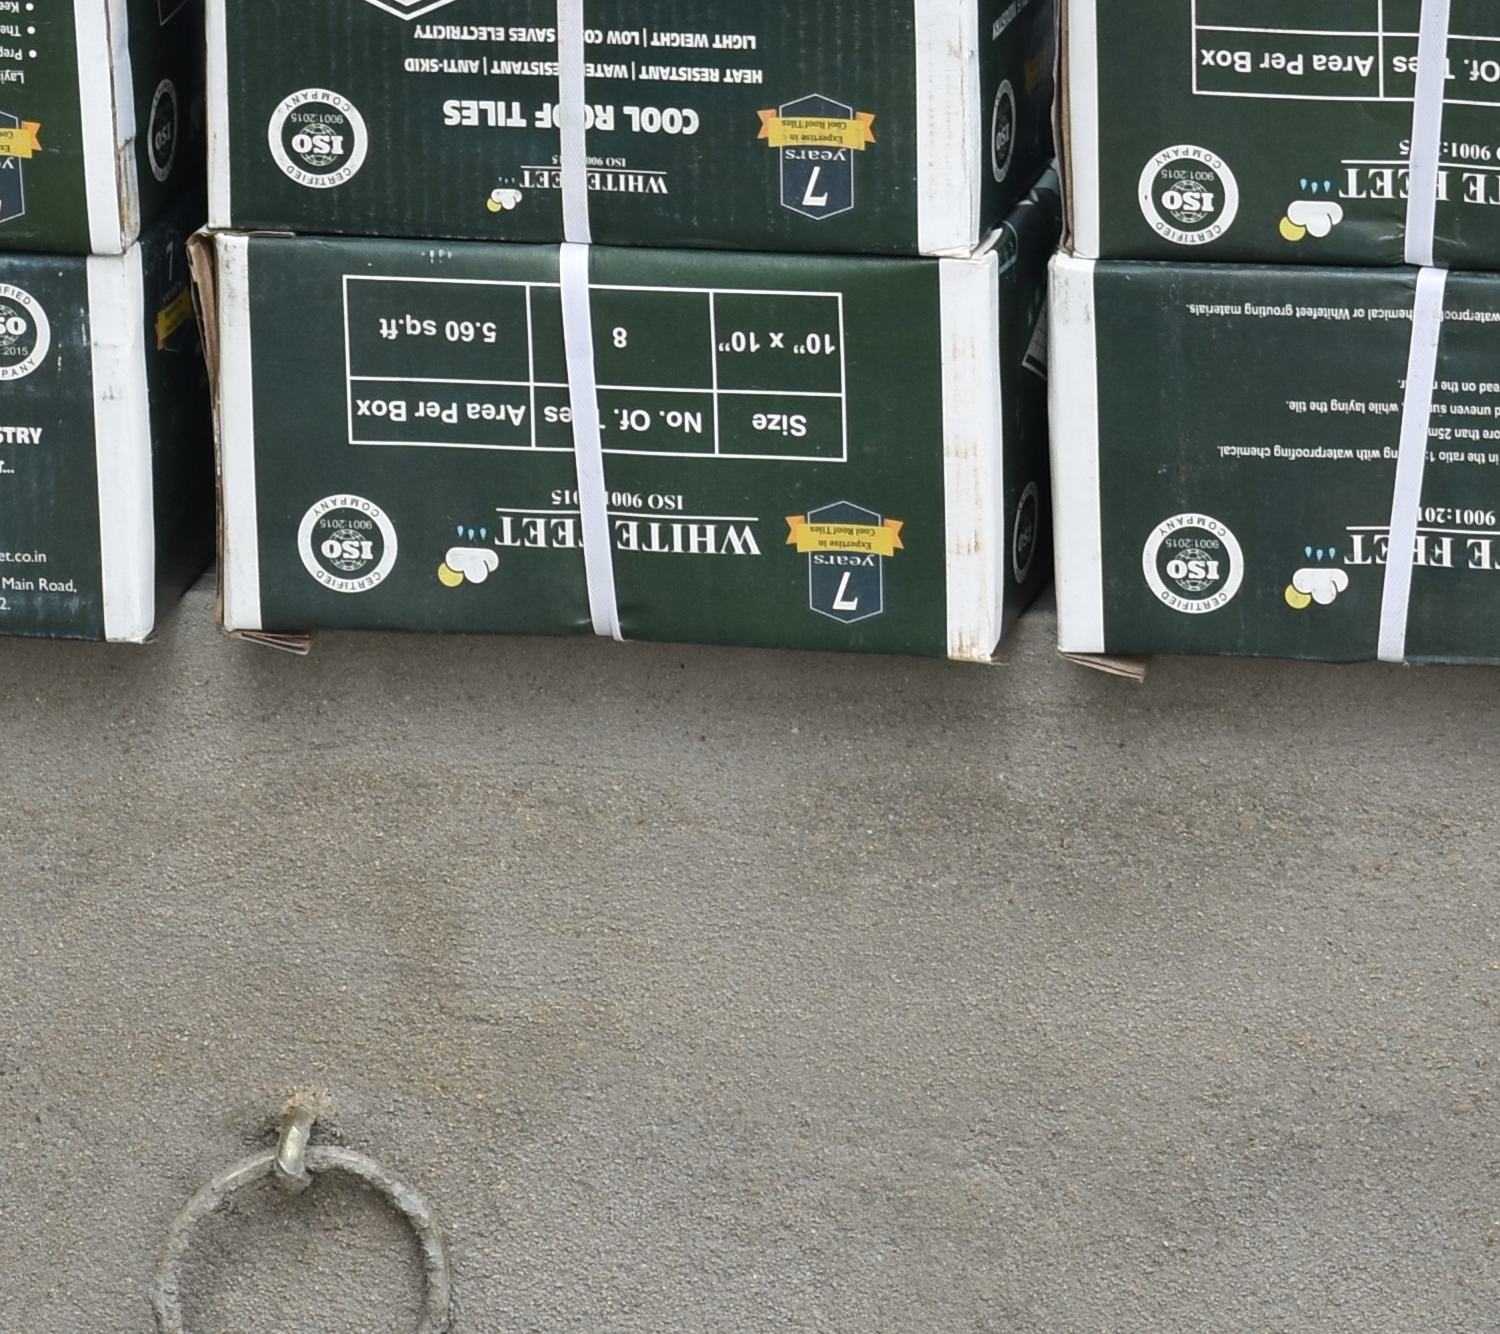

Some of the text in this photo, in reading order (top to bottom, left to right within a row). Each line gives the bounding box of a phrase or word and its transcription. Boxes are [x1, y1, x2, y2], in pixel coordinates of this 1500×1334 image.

[0, 24, 23, 38] The
[413, 24, 757, 51] LIGHT WEIGHT SAVES ELECTRICITY
[403, 57, 764, 85] HEAT RESISTANT ANTI-SKID
[442, 99, 526, 128] TILES
[621, 104, 700, 135] COOL
[584, 169, 669, 196] WHITE
[801, 165, 829, 207] 7
[378, 313, 497, 344] 5.60 sq.ft
[355, 399, 527, 427] Area Per Box
[751, 413, 808, 437] Size
[614, 519, 762, 556] WHITE
[812, 552, 875, 569] years
[831, 571, 859, 611] 7
